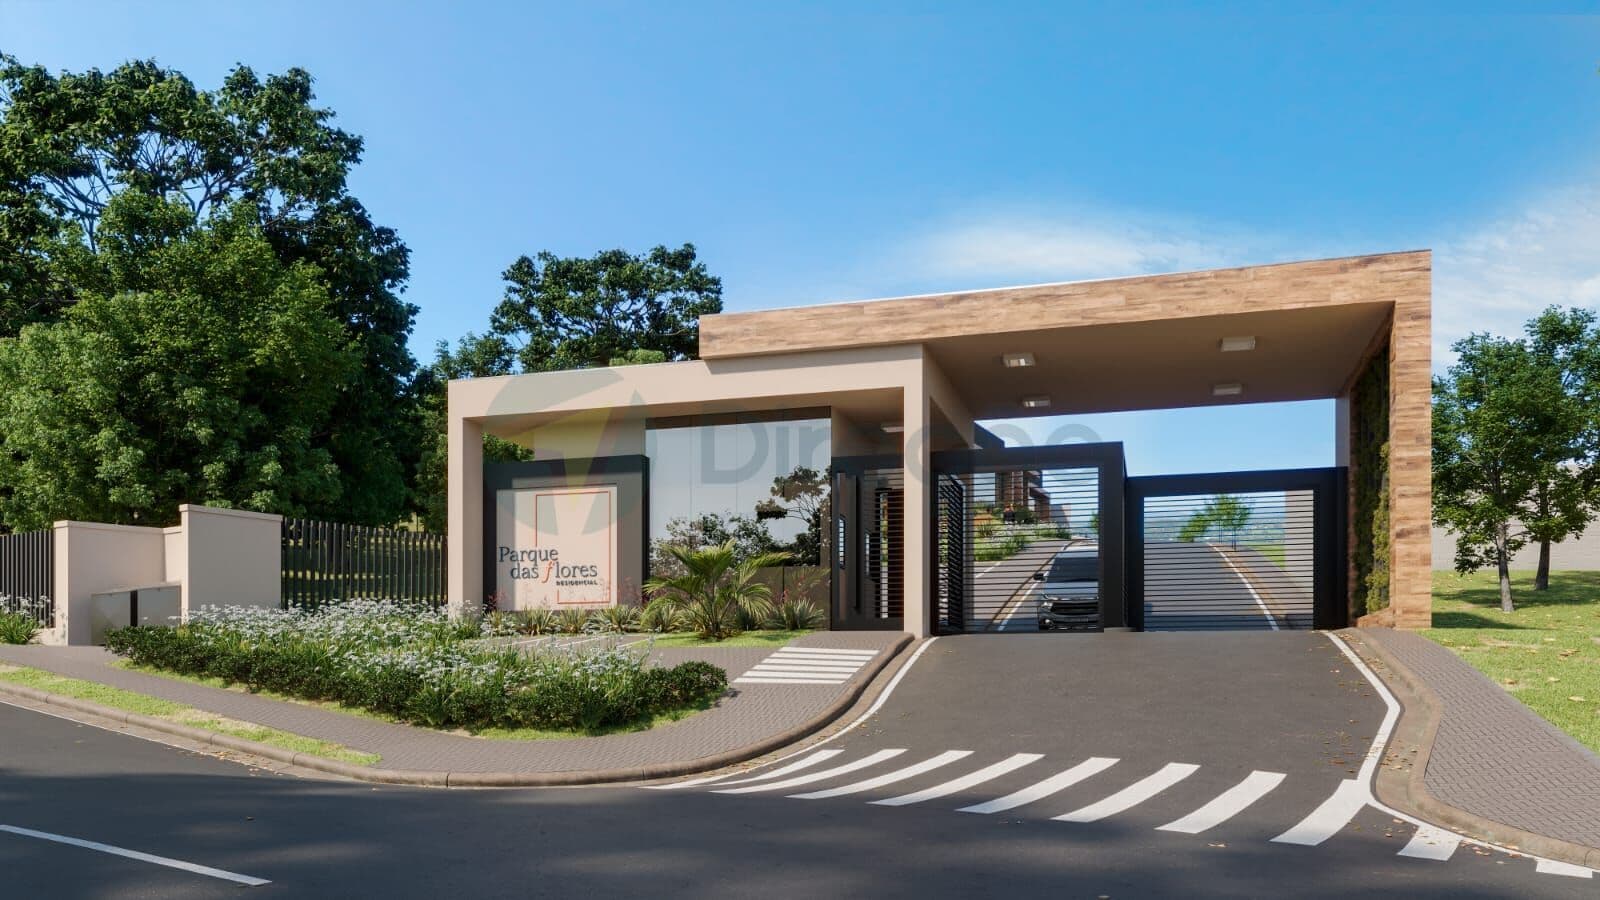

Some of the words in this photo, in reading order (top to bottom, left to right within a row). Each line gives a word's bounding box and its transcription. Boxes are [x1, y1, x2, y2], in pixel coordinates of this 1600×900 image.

[498, 546, 559, 567] Parque
[510, 562, 540, 580] das
[541, 560, 598, 584] flores
